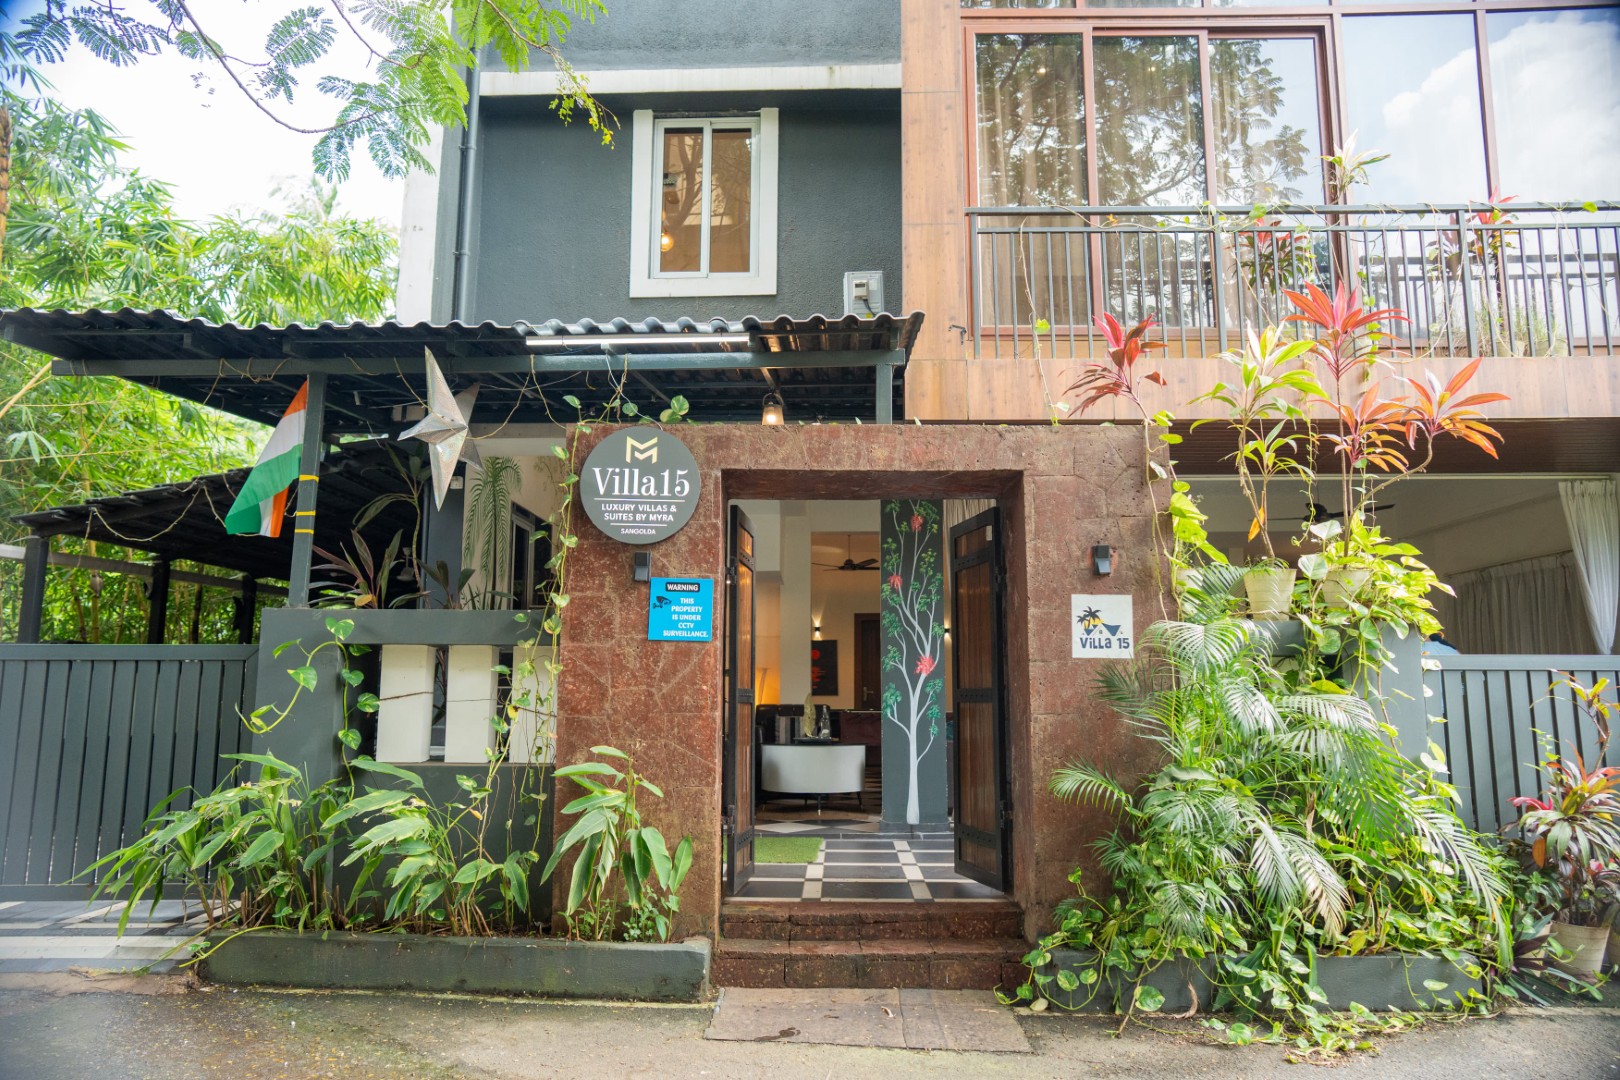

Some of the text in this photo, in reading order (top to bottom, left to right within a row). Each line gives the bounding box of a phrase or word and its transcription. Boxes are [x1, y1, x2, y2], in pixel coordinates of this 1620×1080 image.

[601, 503, 677, 512] LUXURY VILLAS &
[604, 512, 674, 522] SUITES BY MYRA
[667, 583, 699, 591] WARNING
[671, 605, 703, 613] PROPERTY
[663, 630, 709, 638] SURVEILLANCE.
[1116, 637, 1130, 649] 15
